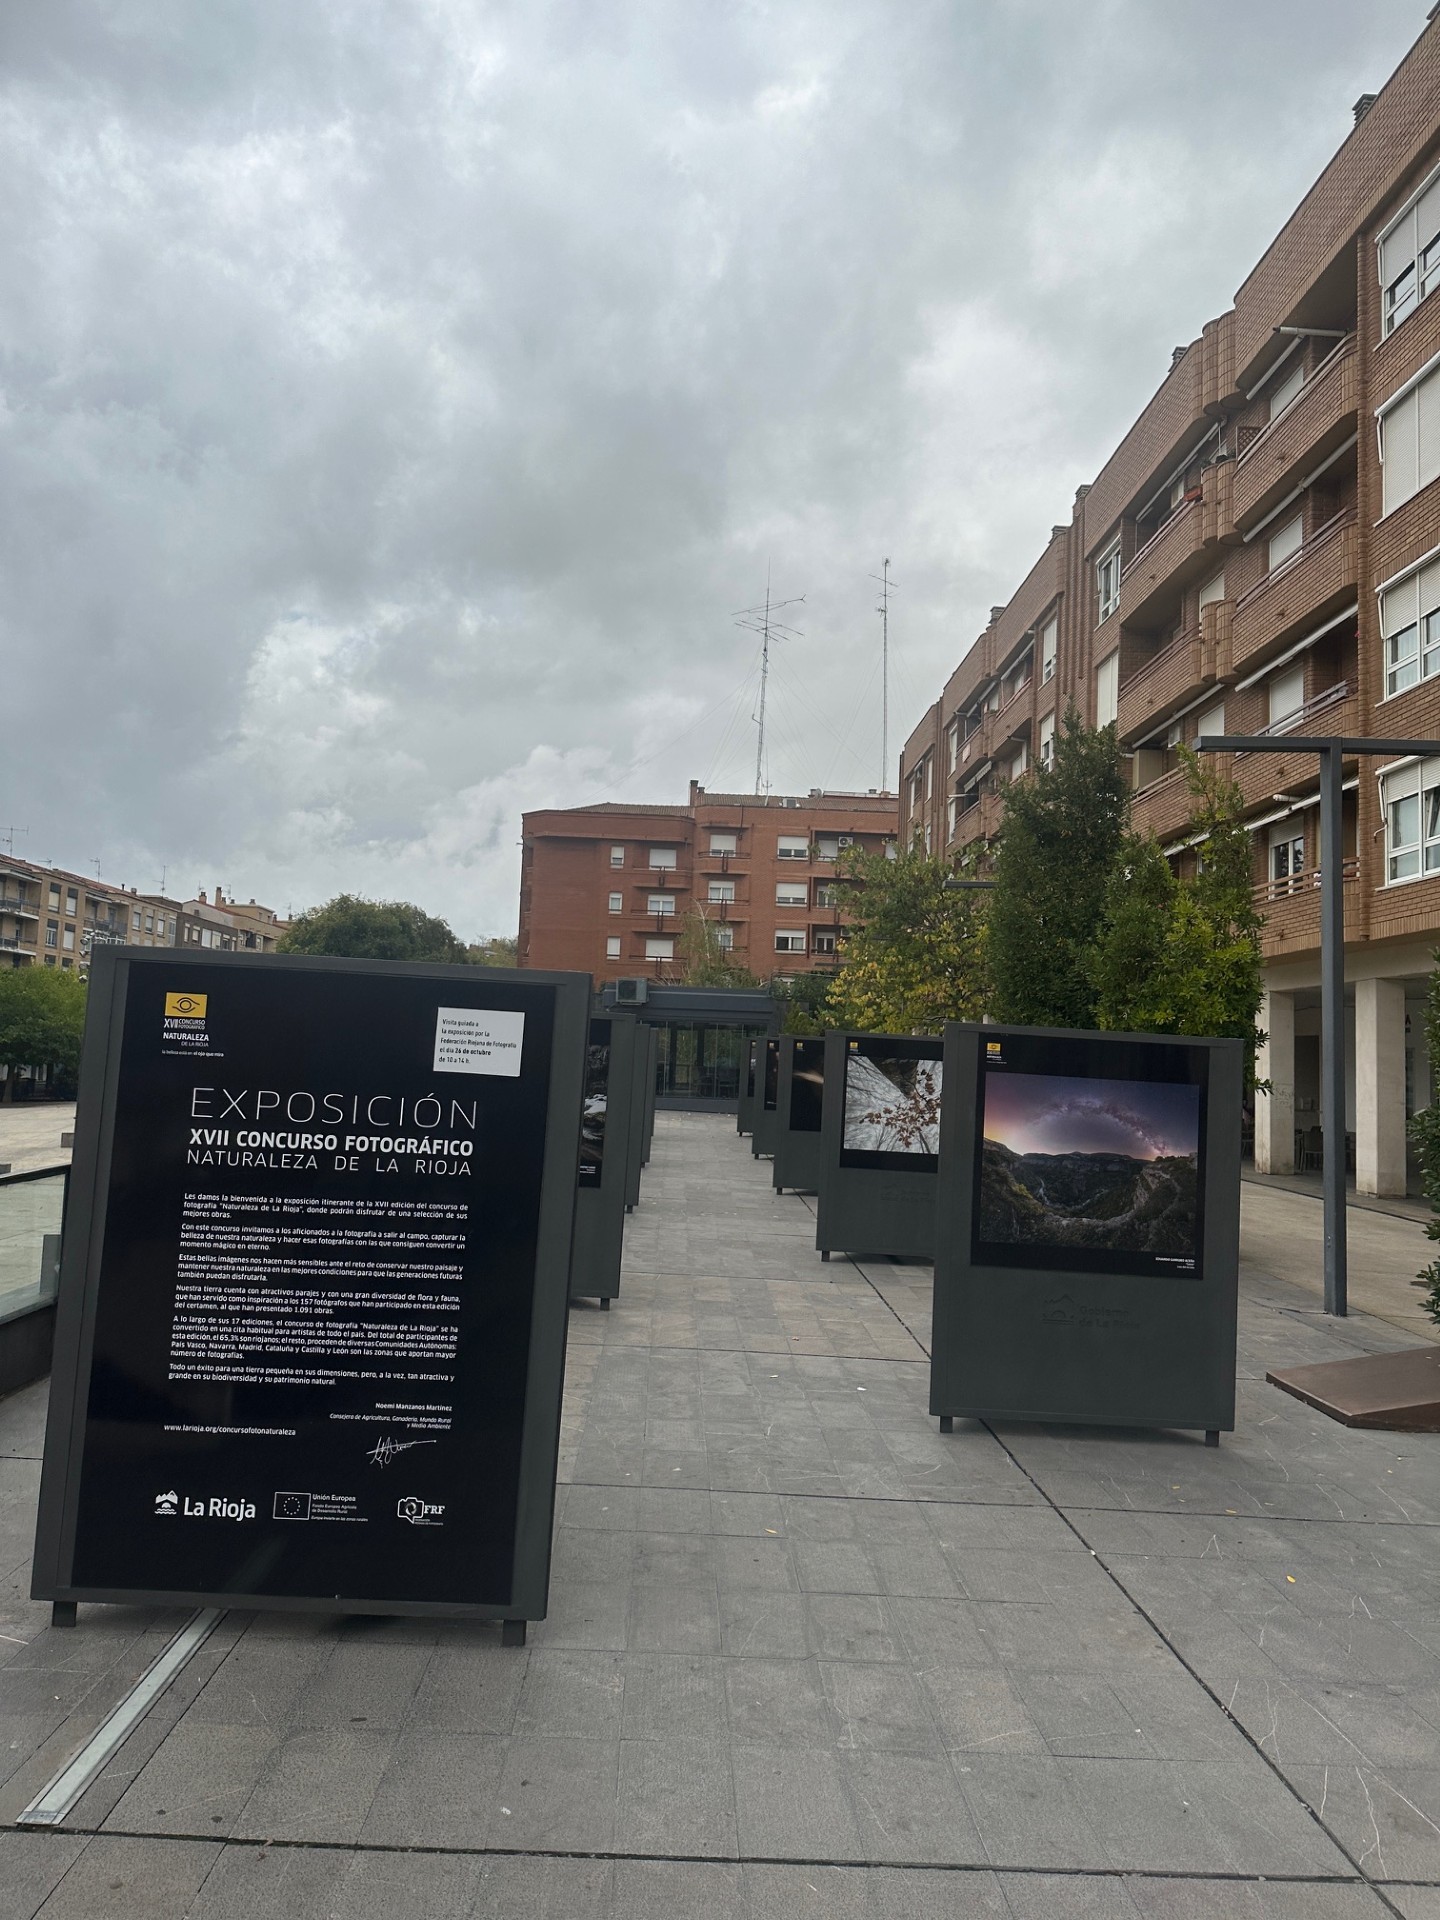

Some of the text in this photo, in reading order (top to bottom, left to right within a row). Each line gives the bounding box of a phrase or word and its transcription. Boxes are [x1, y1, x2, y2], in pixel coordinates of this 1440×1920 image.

[164, 1018, 178, 1028] XVII
[163, 1032, 209, 1041] NATURALEZA
[191, 1087, 477, 1130] EXPOSICIÓN
[189, 1129, 473, 1156] XVII CONCURSO FOTOGRÁFICO
[187, 1150, 471, 1175] NATURALEZA DE LA RIOJA
[197, 1193, 220, 1201] damos
[230, 1194, 268, 1203] bienvenida
[322, 1198, 354, 1206] itinerante
[183, 1209, 210, 1219] mejores
[306, 1206, 328, 1214] donde
[356, 1208, 385, 1216] disfrutar
[195, 1223, 210, 1231] este
[242, 1225, 274, 1234] invitamos
[292, 1227, 330, 1236] aficionados
[431, 1233, 458, 1242] capturar
[180, 1240, 212, 1248] momento
[179, 1253, 196, 1262] Estas
[197, 1254, 217, 1262] bellas
[263, 1257, 282, 1265] hacen
[298, 1258, 328, 1266] sensibles
[409, 1262, 434, 1271] nuestro
[435, 1263, 458, 1273] paisaje
[206, 1271, 230, 1281] puedan
[255, 1304, 293, 1314] presentado
[168, 1372, 192, 1381] grande
[212, 1373, 257, 1382] biodiversidad
[273, 1376, 310, 1386] patrimonio
[164, 1424, 296, 1436] www.larioja.org/concursofotonaturaleza
[184, 1497, 256, 1521] La Rioja
[424, 1505, 445, 1514] FRF
